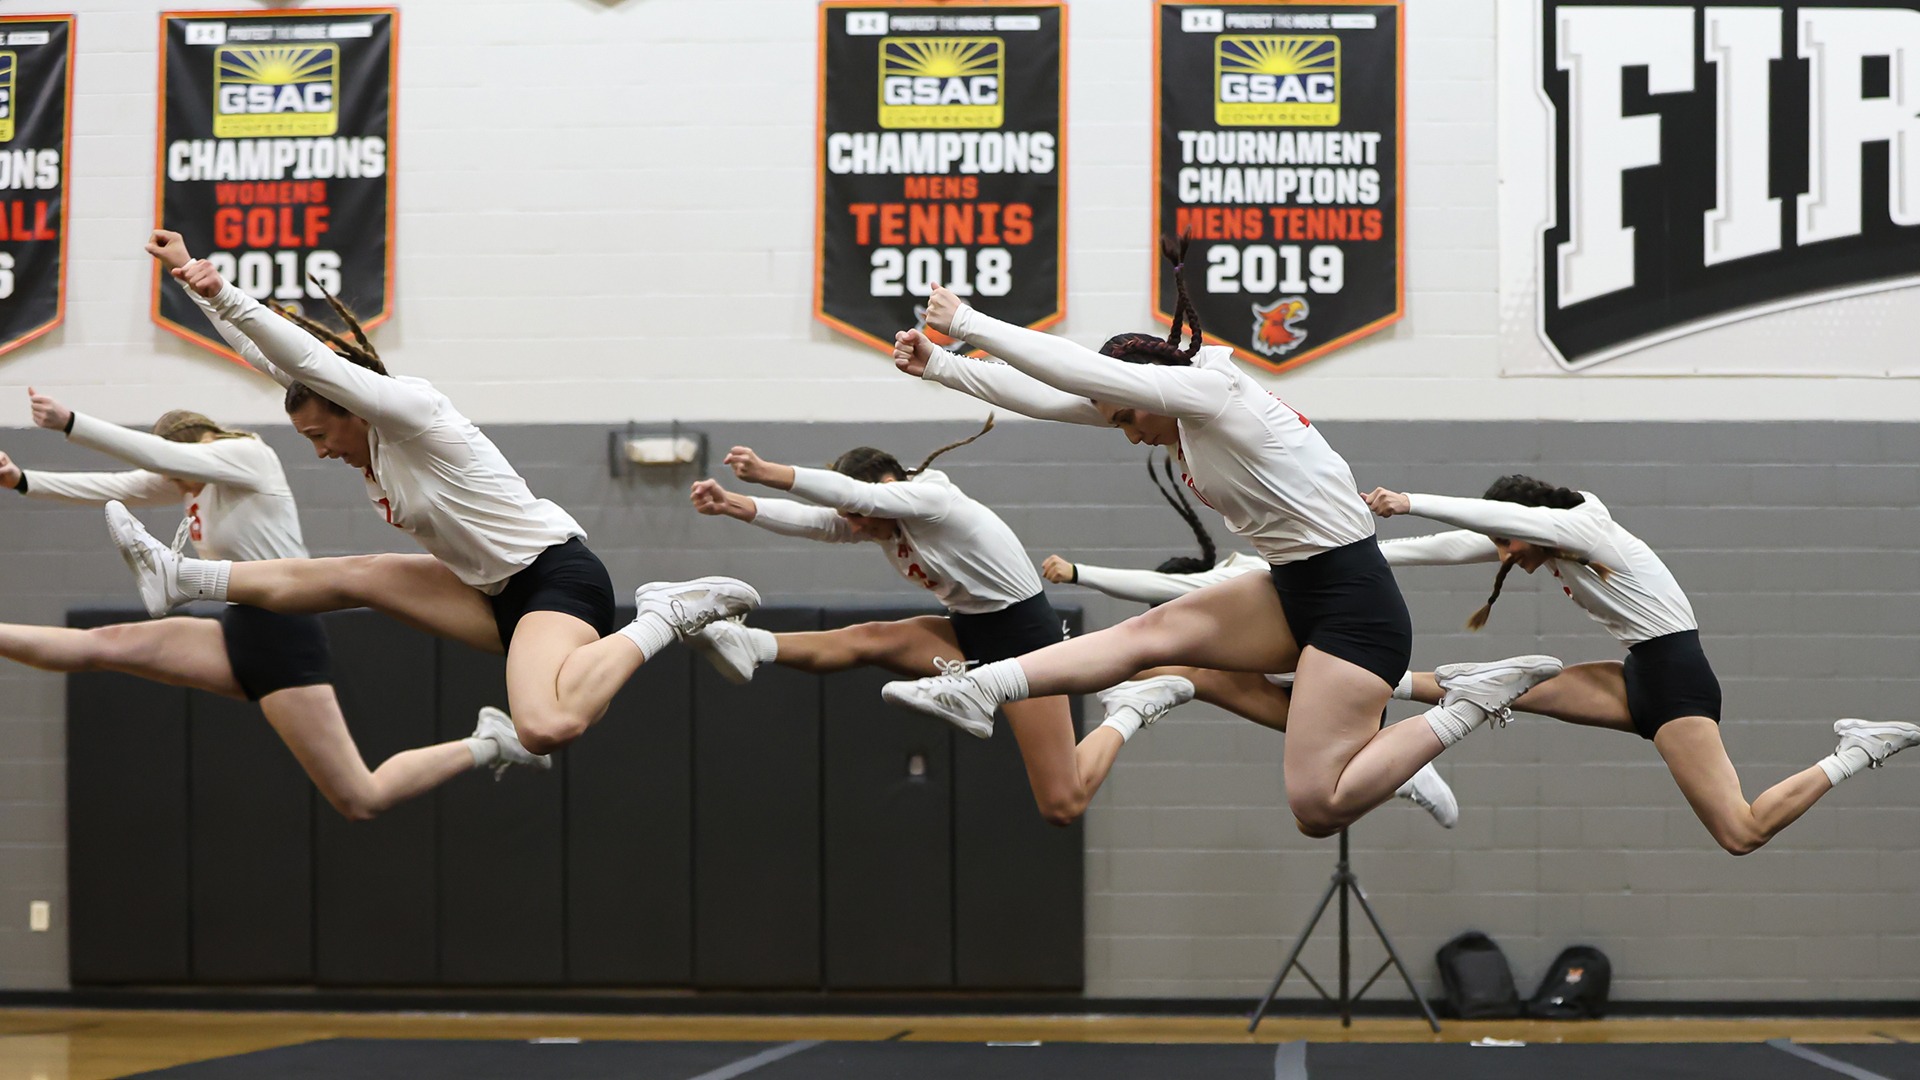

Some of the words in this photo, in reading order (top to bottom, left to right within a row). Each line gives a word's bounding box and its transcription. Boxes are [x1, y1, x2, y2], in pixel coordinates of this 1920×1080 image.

[219, 83, 332, 114] GSAC
[884, 76, 998, 105] GSAC
[1220, 74, 1335, 103] GSAC
[168, 137, 386, 181] CHAMPIONS
[828, 132, 1055, 174] CHAMPIONS
[1178, 131, 1381, 164] TOURNAMENT
[1555, 5, 1920, 309] FIR
[215, 182, 327, 205] WOMENS
[904, 176, 978, 199] MENS
[1178, 168, 1381, 204] CHAMPIONS
[214, 206, 330, 248] GOLF
[848, 203, 1034, 245] TENNIS
[1176, 208, 1264, 240] MENS
[1269, 208, 1383, 240] TENNIS
[870, 248, 1012, 297] 2018
[1206, 245, 1344, 294] 2019
